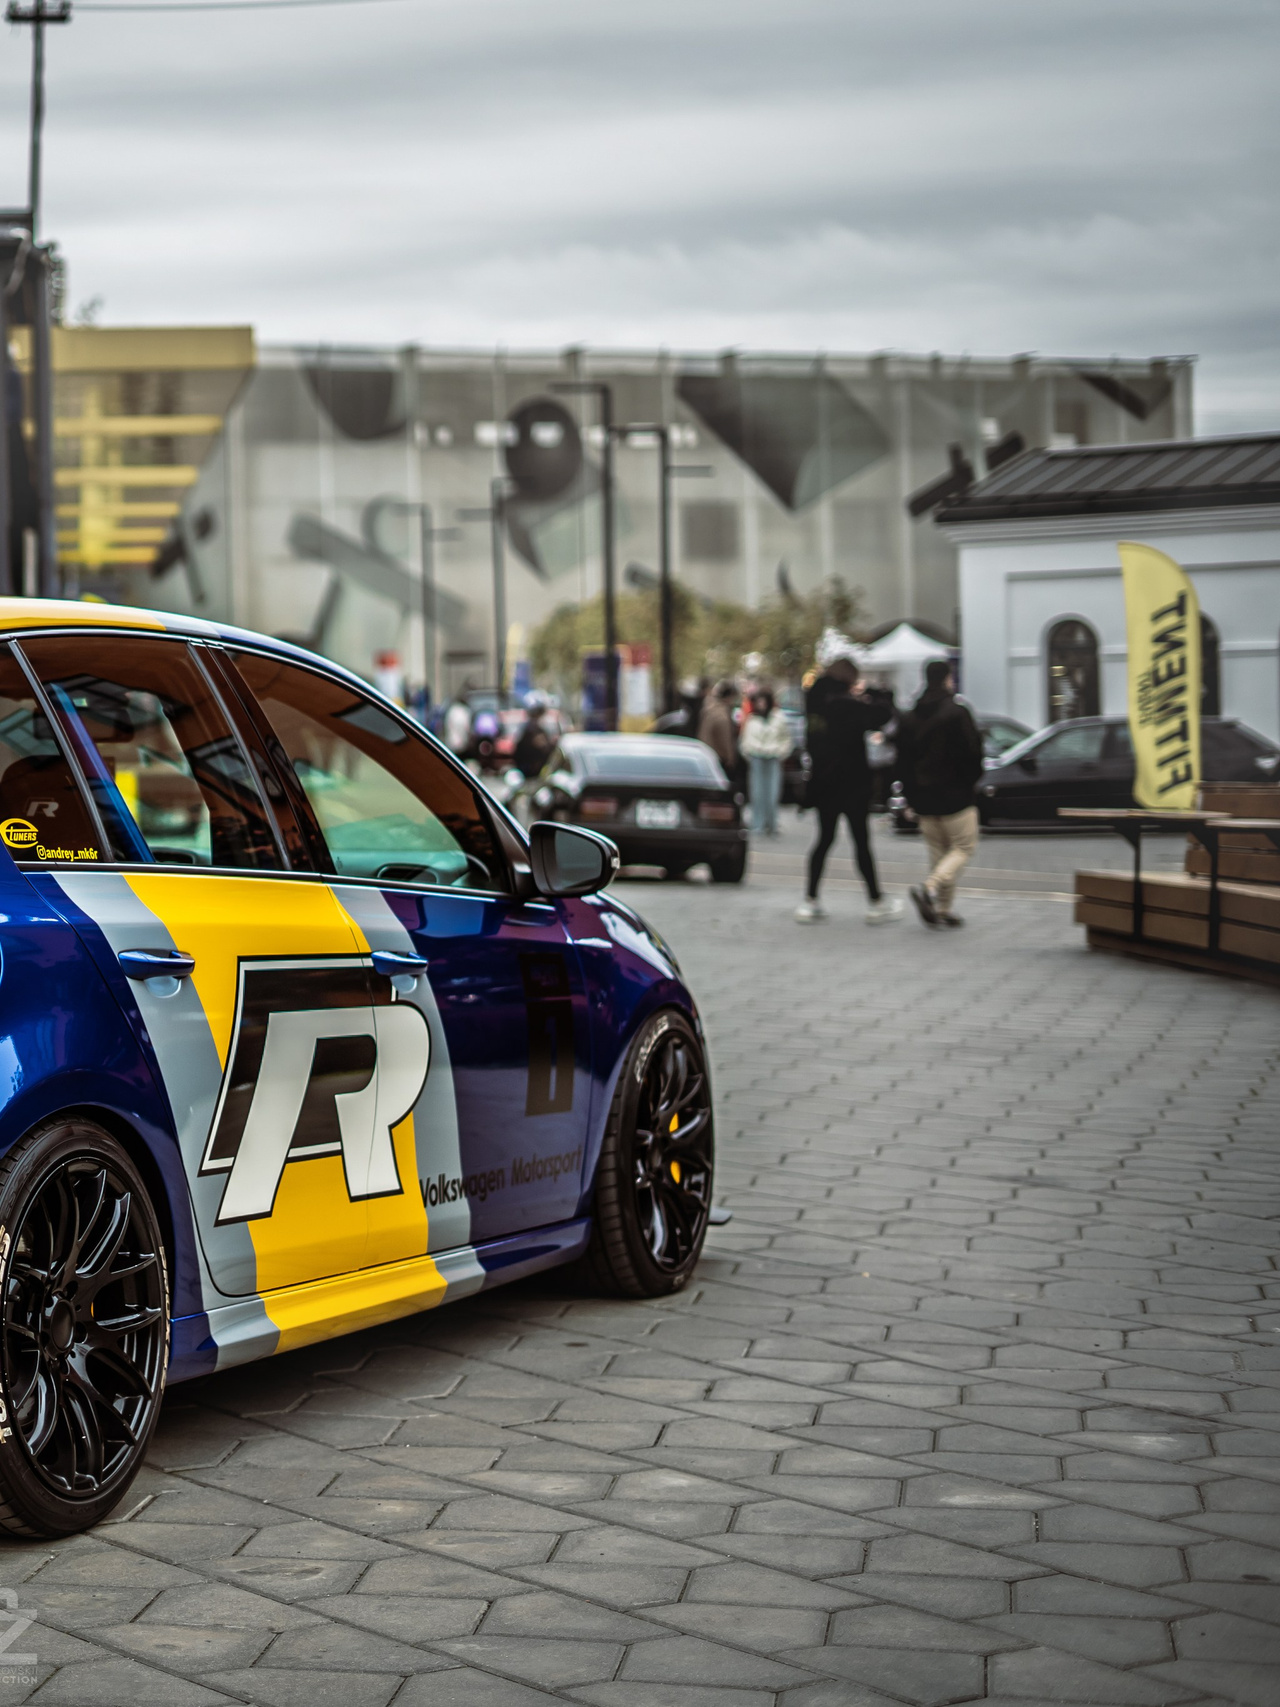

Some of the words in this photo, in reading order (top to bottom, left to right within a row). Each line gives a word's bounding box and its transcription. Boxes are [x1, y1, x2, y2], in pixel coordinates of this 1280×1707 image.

[213, 999, 432, 1227] R
[419, 1167, 505, 1208] Volkswagen
[510, 1145, 584, 1186] Motorsport
